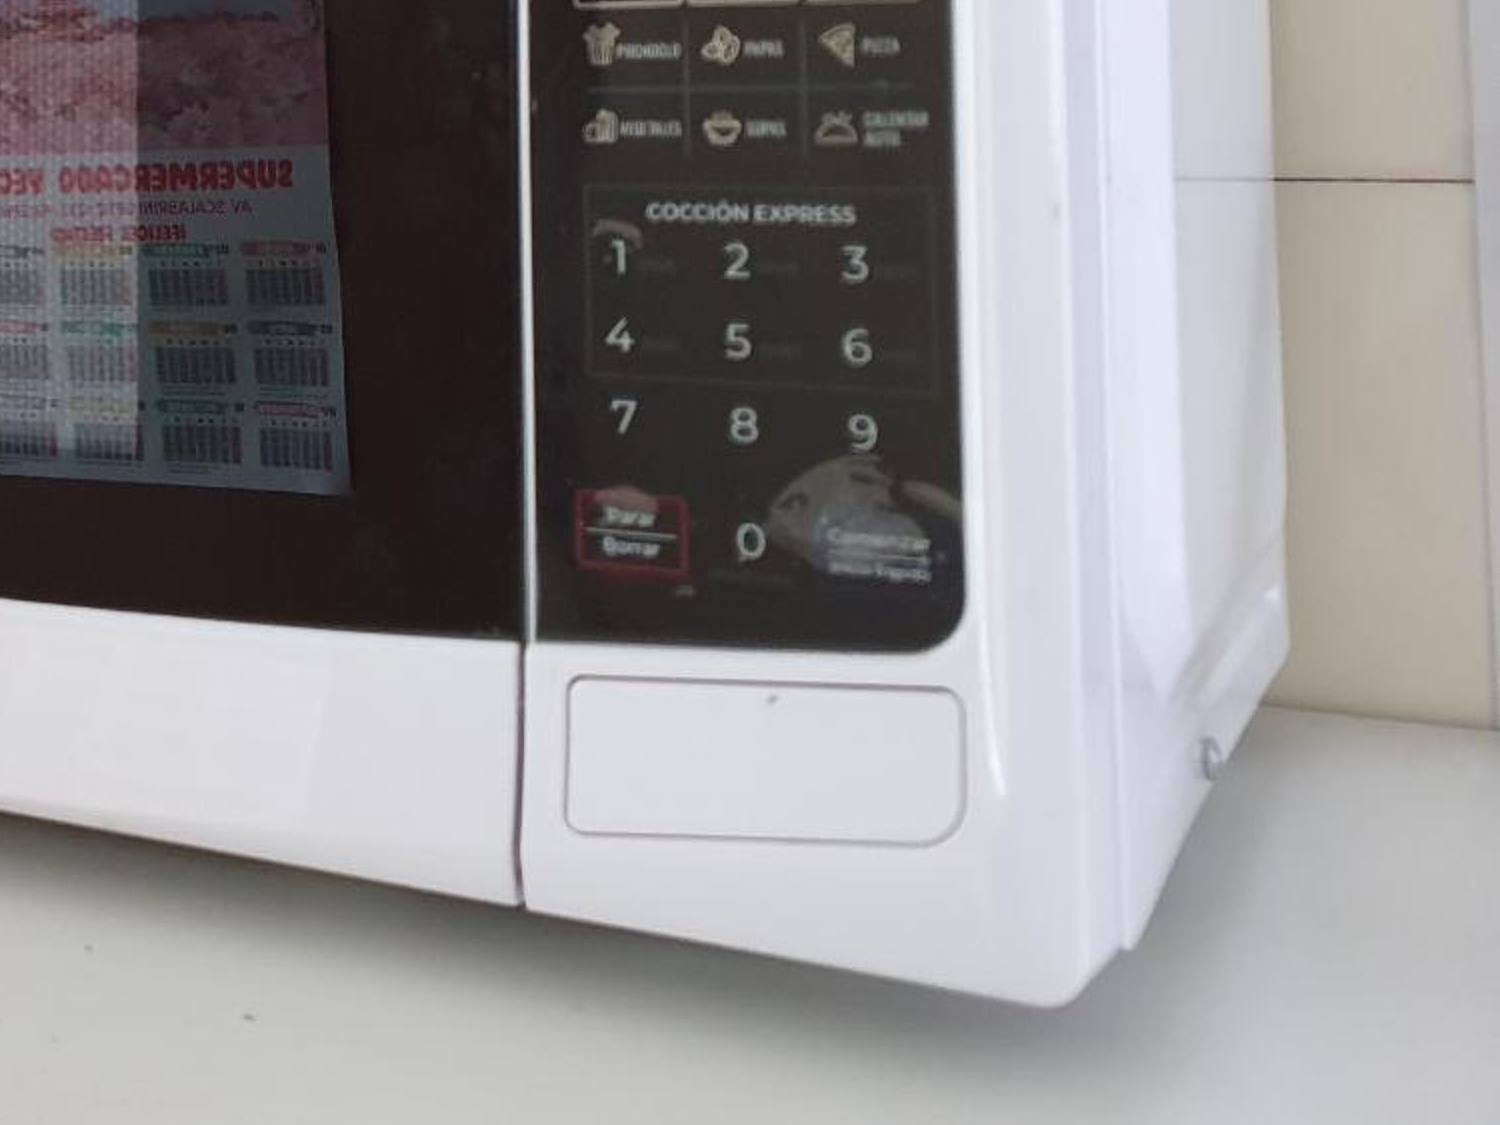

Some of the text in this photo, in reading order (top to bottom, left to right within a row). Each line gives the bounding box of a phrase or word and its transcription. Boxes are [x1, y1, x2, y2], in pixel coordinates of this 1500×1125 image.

[645, 200, 857, 225] COCCIÓN EXPRESS
[610, 239, 626, 274] 1
[724, 241, 750, 279] 2
[842, 245, 869, 284] 3
[605, 317, 634, 352] 4
[724, 323, 752, 360] 5
[842, 328, 872, 367] 6
[610, 400, 637, 434] 7
[729, 407, 759, 444] 8
[848, 414, 879, 452] 9
[603, 537, 660, 557] Borrar
[736, 523, 765, 559] 0
